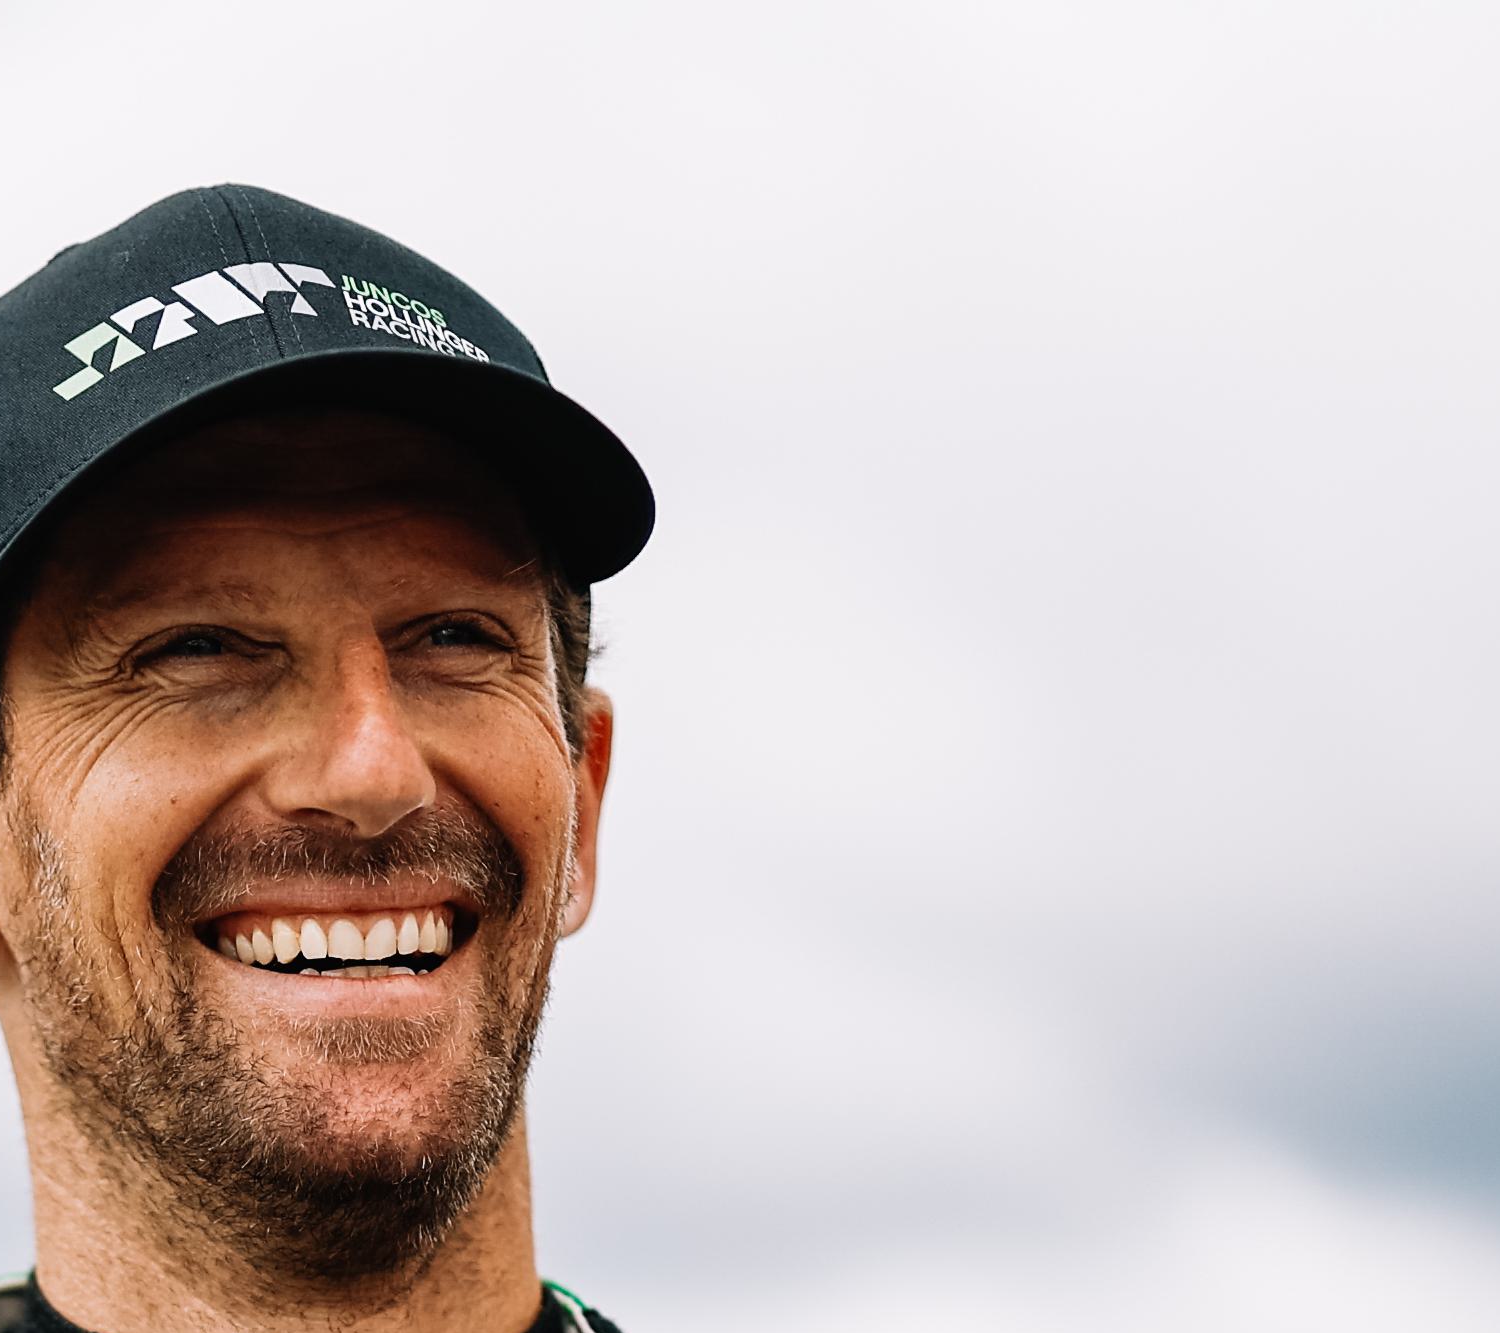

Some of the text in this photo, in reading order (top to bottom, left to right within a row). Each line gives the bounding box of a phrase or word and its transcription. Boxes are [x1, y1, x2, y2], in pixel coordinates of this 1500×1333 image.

[341, 274, 447, 328] JUNCOS
[342, 290, 490, 363] HOLLINGER
[349, 308, 456, 358] RACING
